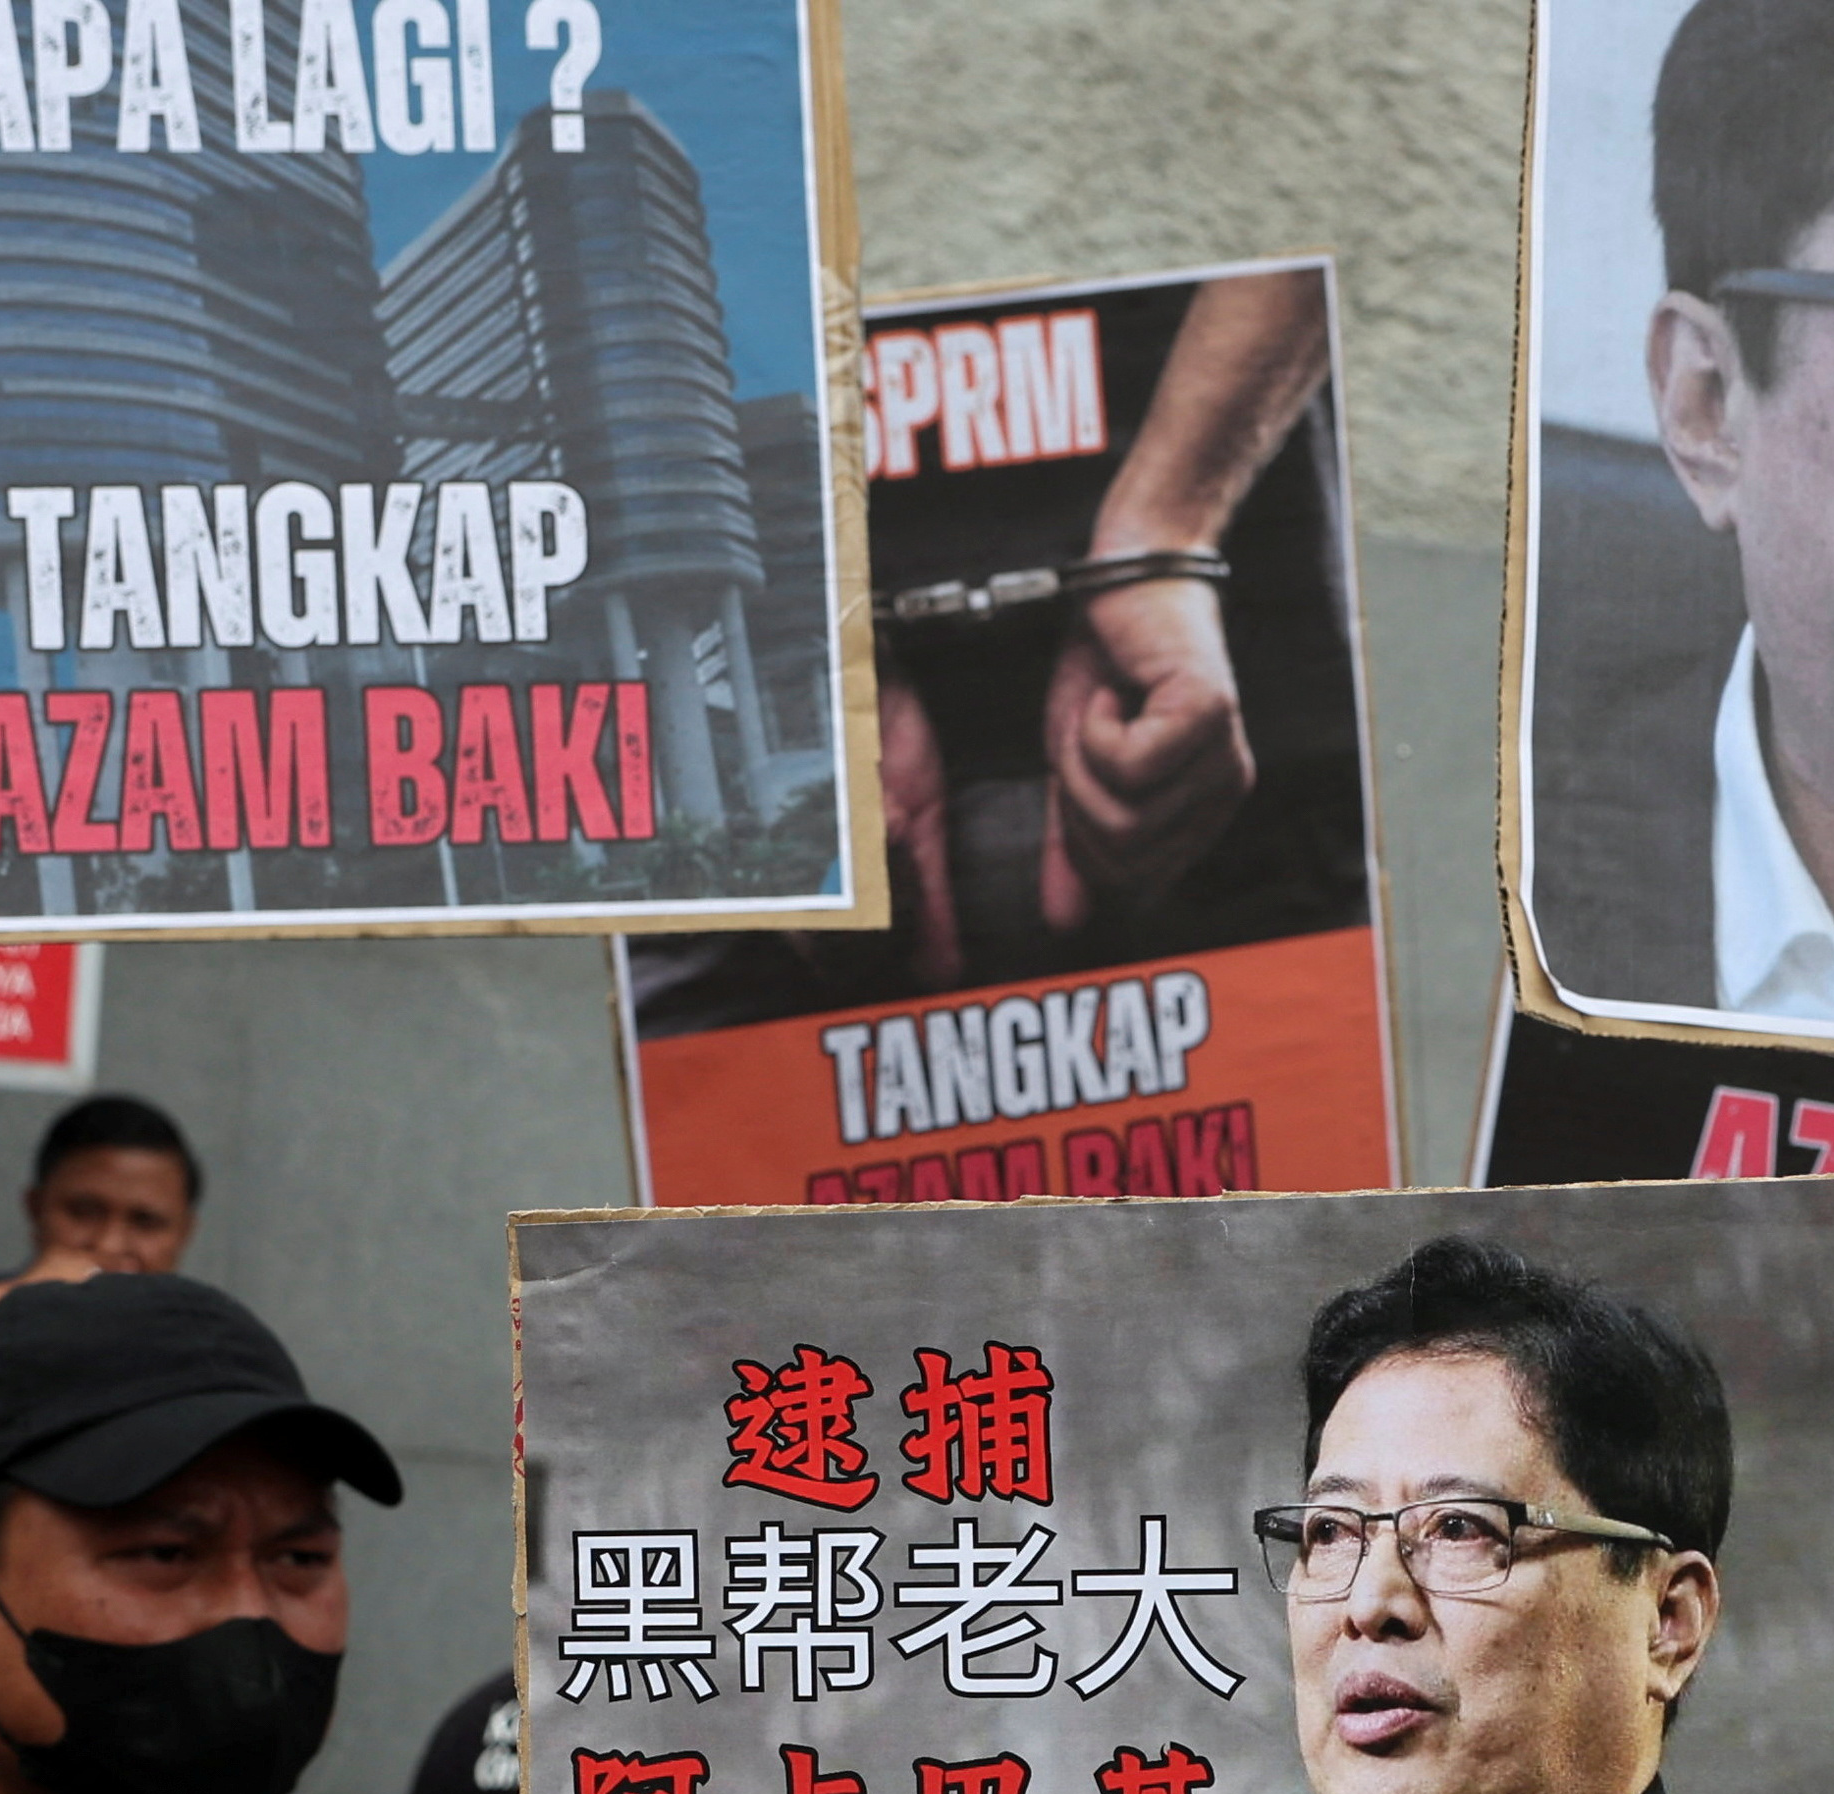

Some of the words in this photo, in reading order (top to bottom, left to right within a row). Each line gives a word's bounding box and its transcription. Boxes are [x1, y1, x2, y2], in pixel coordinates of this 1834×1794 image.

[232, 0, 497, 155] LAGI
[525, 0, 604, 153] ?
[6, 480, 589, 651] TANGKAP
[364, 681, 656, 849] BAKI
[821, 966, 1212, 1145] TANGKAP
[723, 1341, 1055, 1511] 逮捕
[558, 1515, 1246, 1703] 黑帮老大
